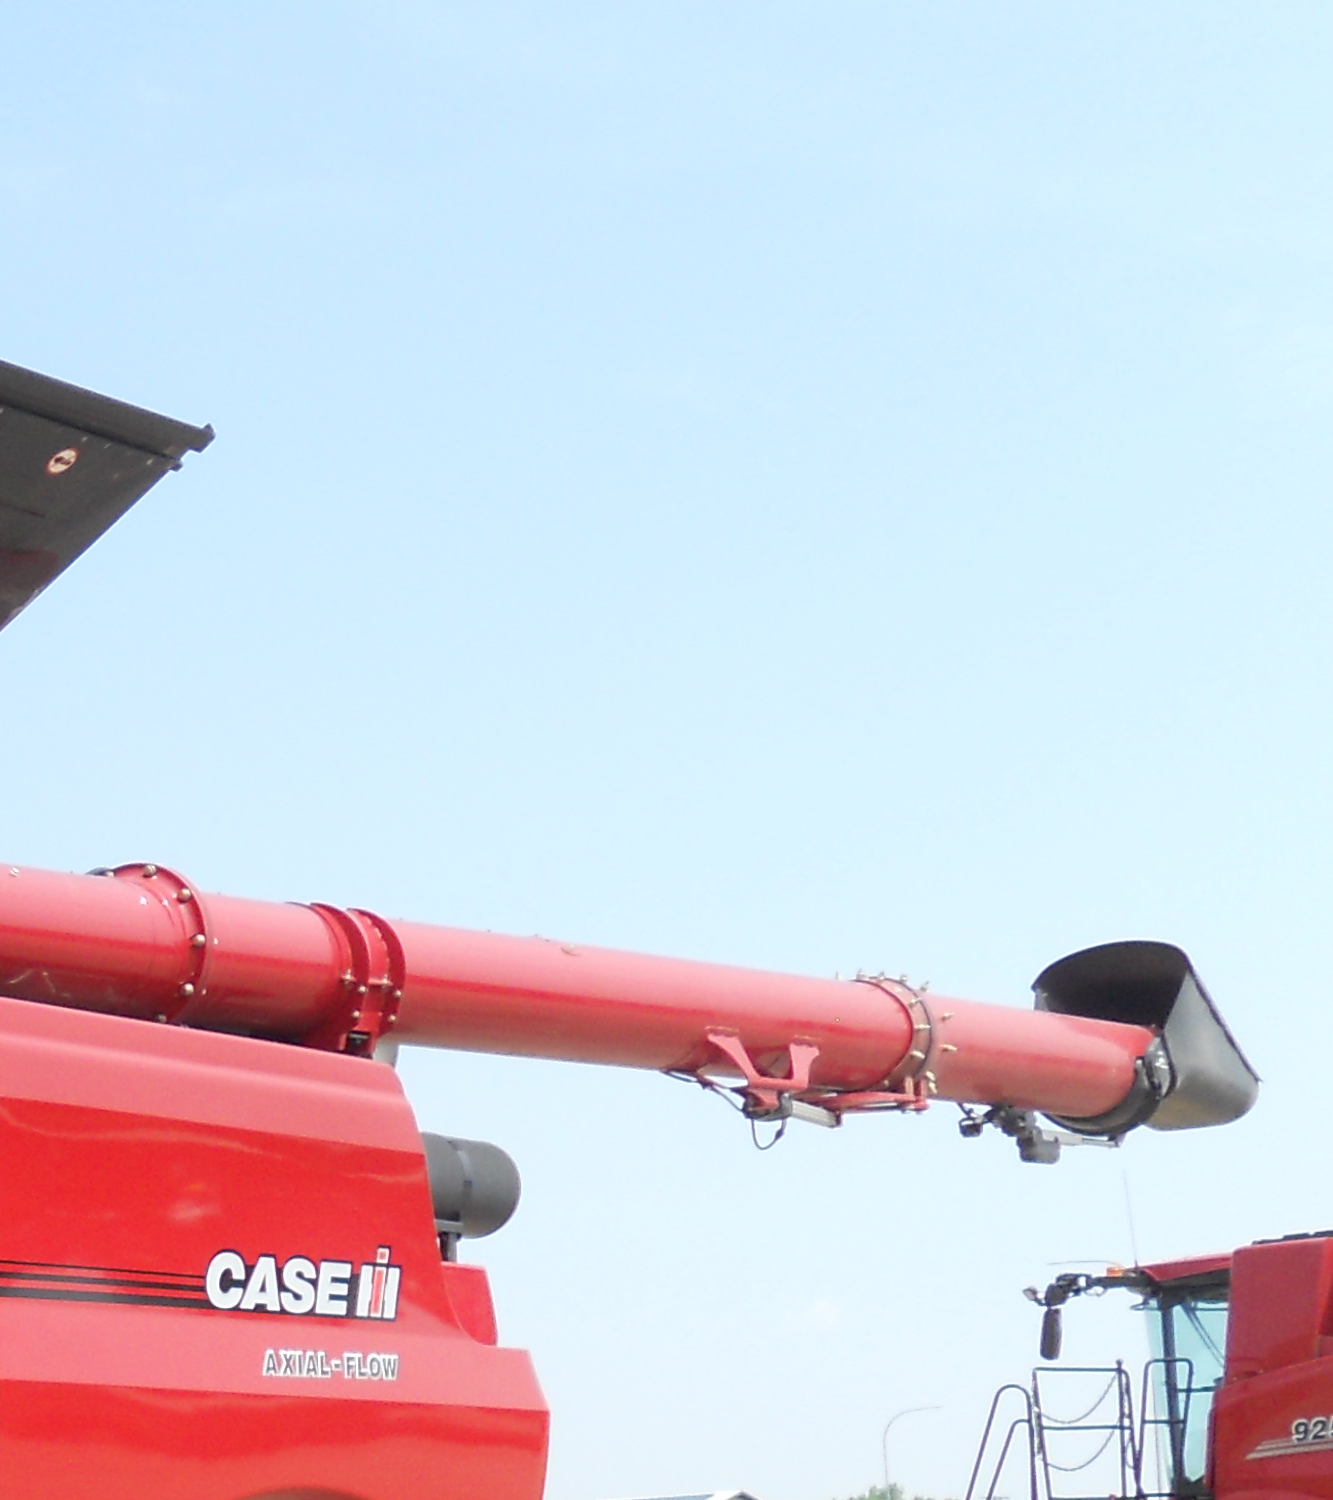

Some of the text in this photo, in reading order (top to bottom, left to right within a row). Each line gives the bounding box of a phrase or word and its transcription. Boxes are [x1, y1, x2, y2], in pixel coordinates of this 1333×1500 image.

[205, 1248, 352, 1317] CASE
[263, 1348, 399, 1381] AXIAL-FLOW
[1291, 1414, 1333, 1443] 92
